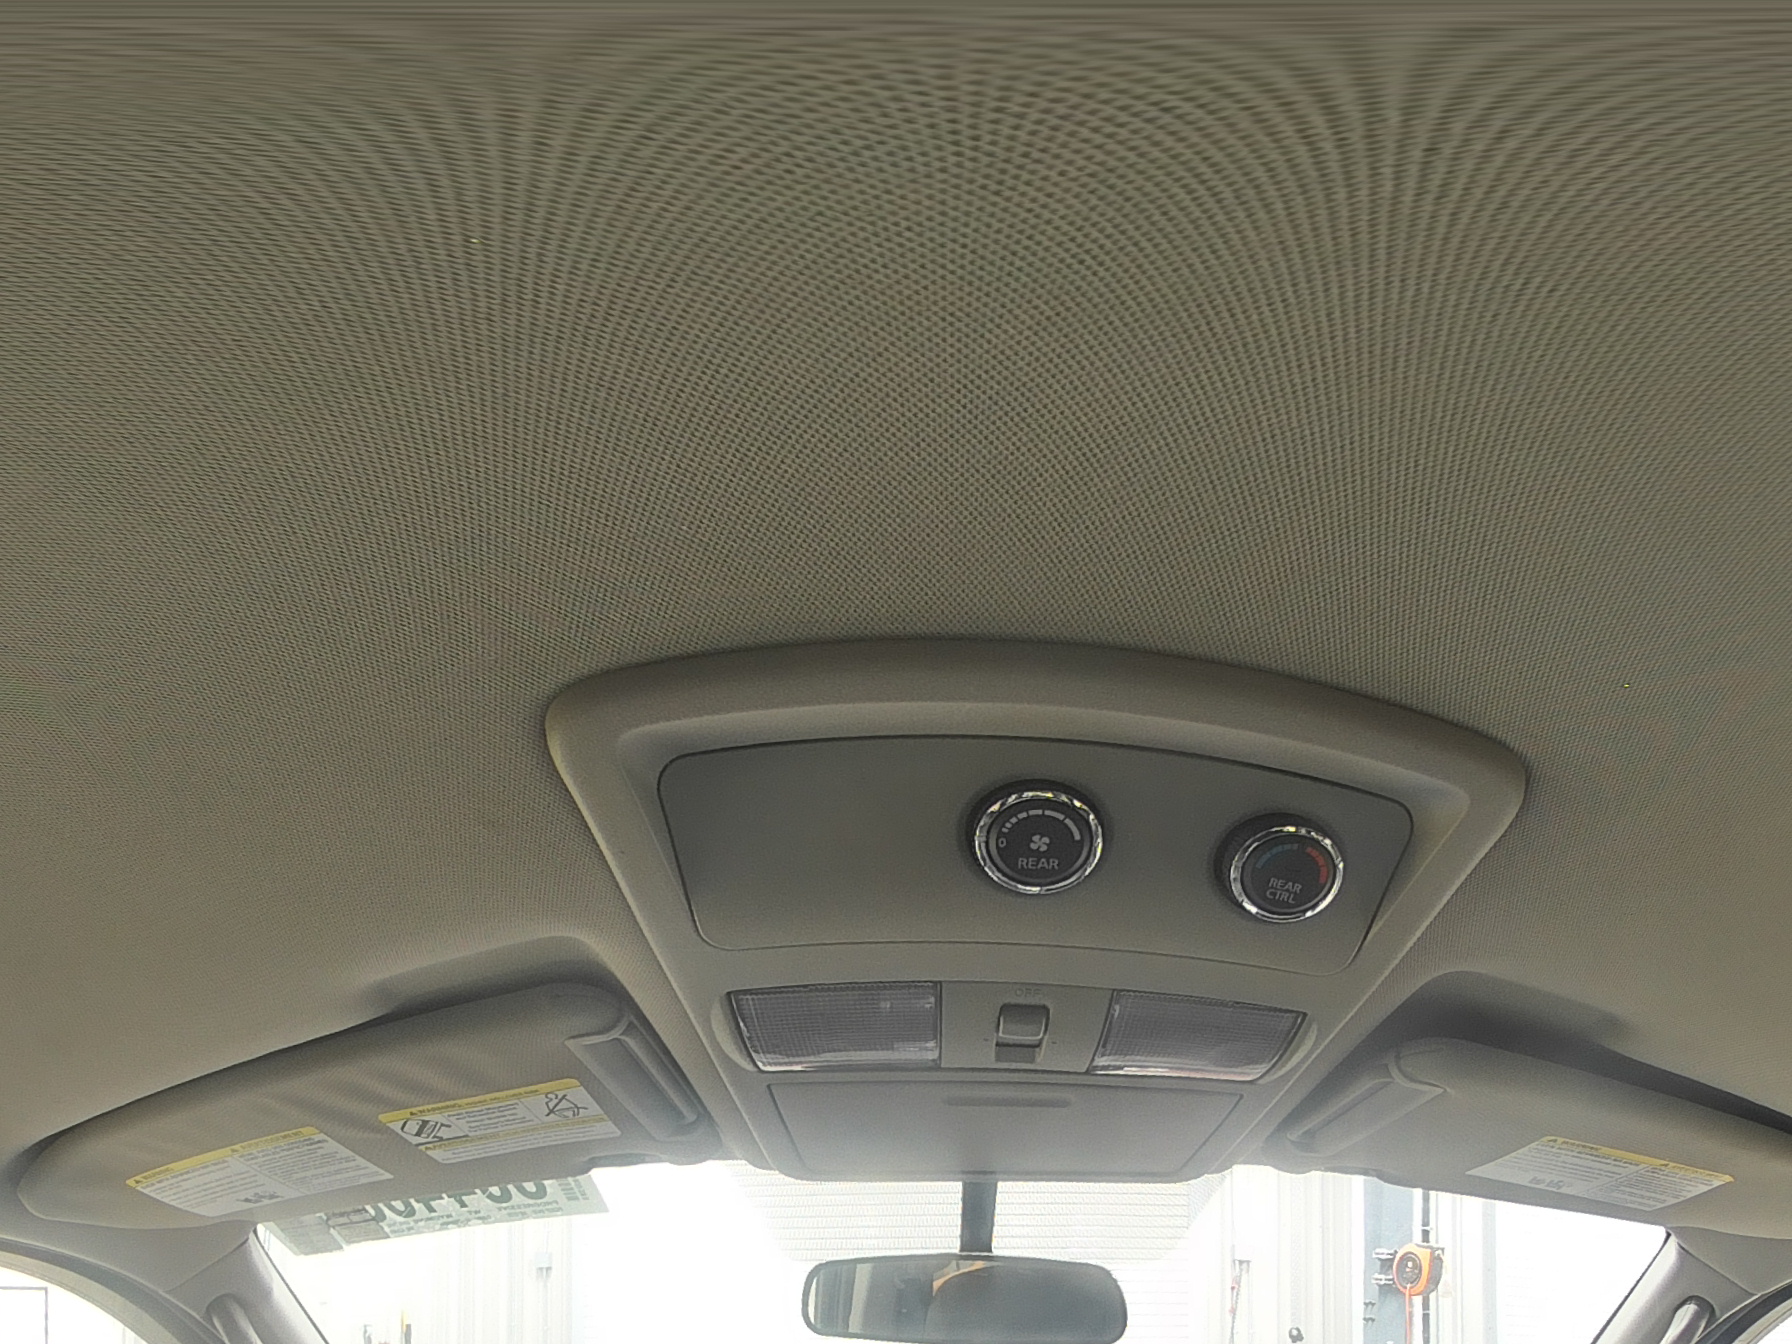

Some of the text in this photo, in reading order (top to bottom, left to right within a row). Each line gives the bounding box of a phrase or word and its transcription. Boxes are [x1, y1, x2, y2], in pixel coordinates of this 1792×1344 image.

[1017, 857, 1060, 871] REAR
[1268, 876, 1303, 895] REAR
[1265, 889, 1297, 905] CTRL
[1014, 987, 1043, 998] OFF
